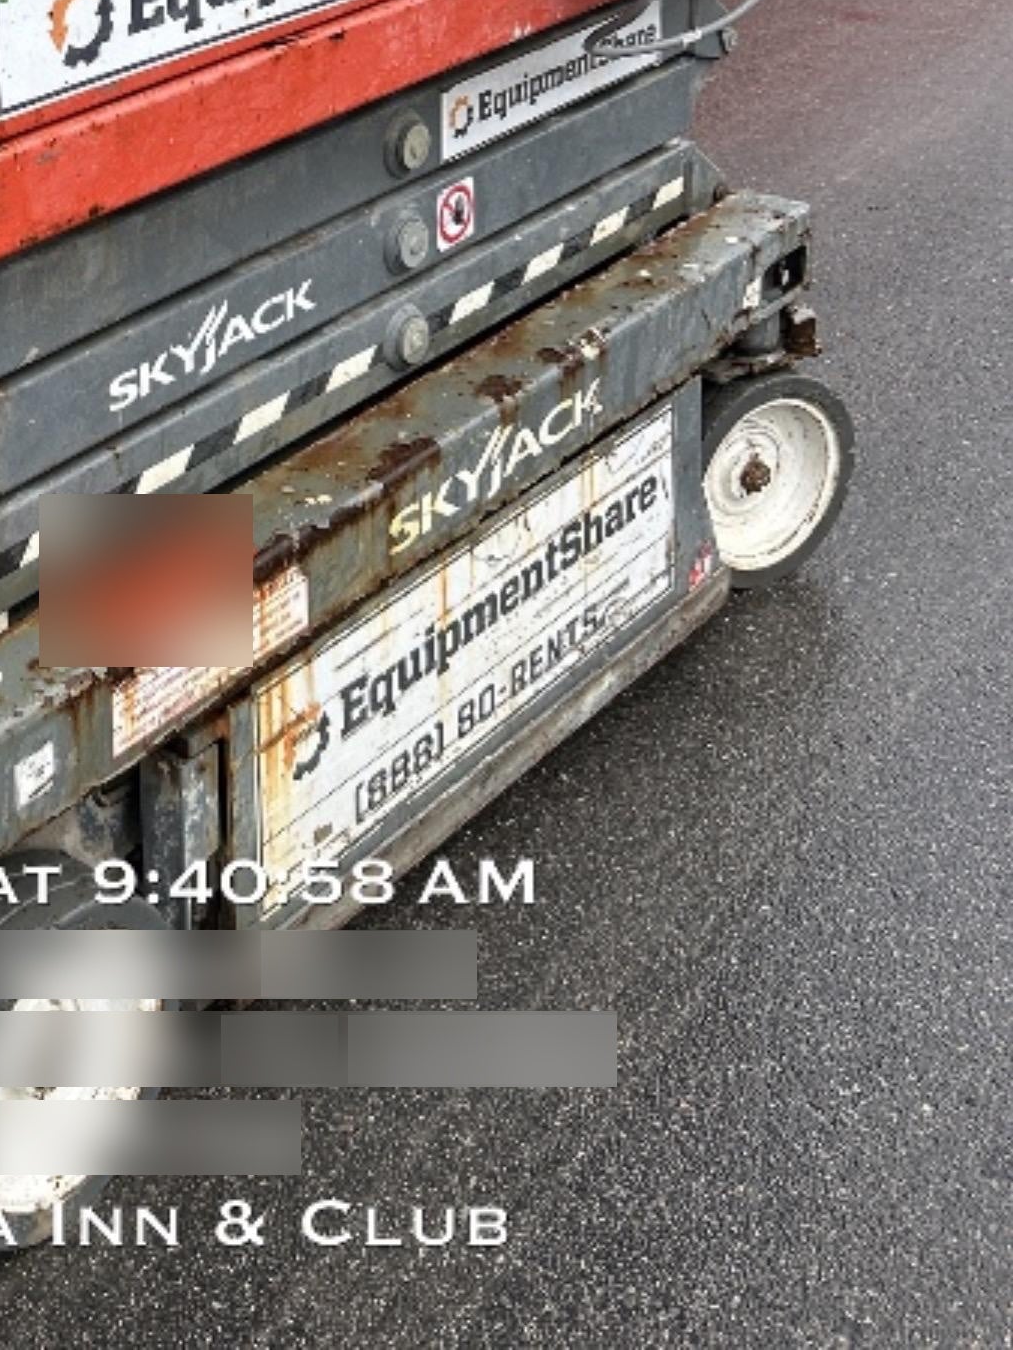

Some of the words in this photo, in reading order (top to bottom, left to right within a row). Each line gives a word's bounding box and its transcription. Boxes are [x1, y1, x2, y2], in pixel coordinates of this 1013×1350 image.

[108, 278, 317, 413] SKYJACK
[388, 377, 605, 555] SKYJACK
[340, 475, 658, 740] EquipmentShare
